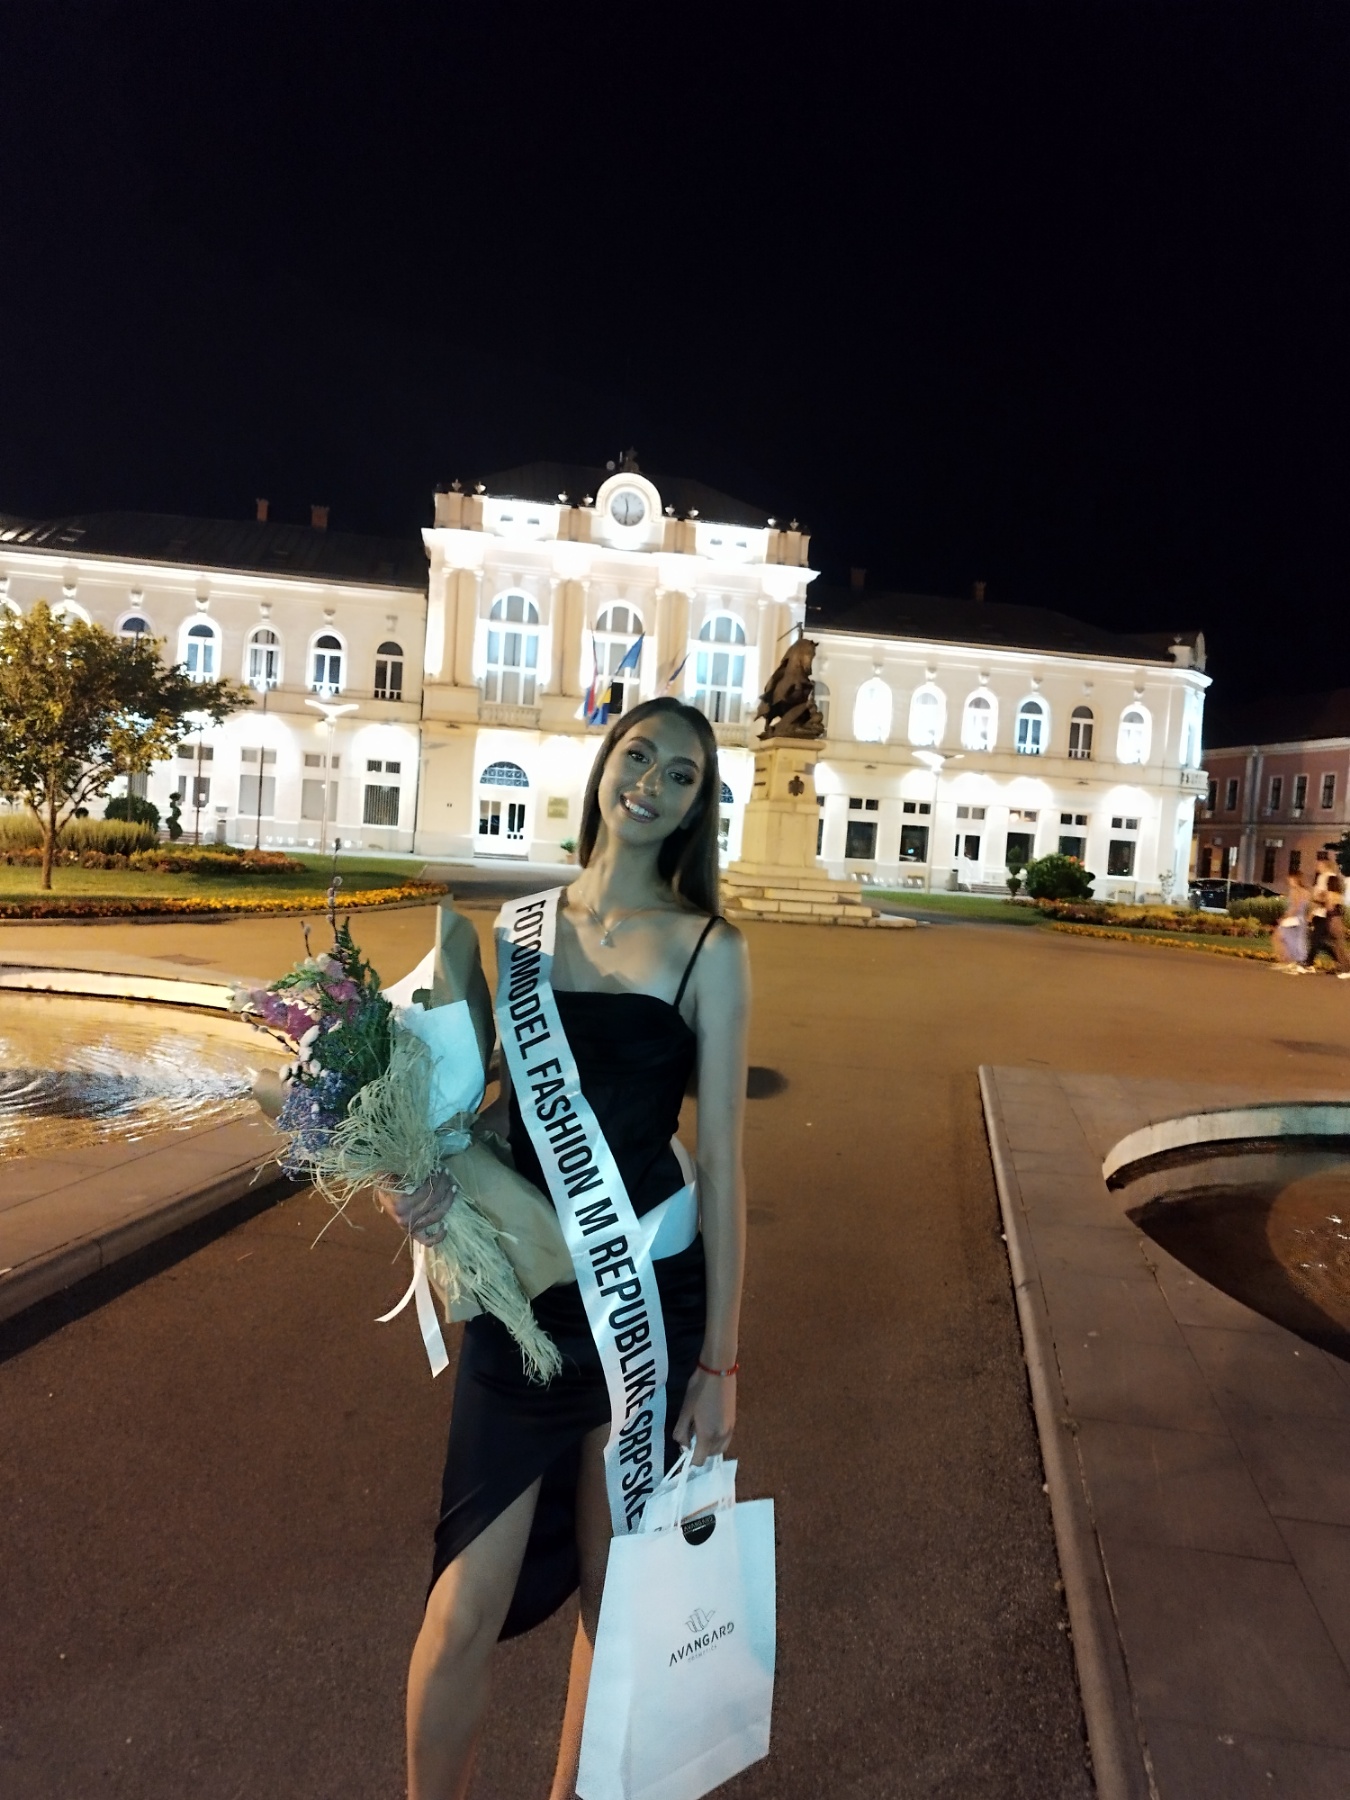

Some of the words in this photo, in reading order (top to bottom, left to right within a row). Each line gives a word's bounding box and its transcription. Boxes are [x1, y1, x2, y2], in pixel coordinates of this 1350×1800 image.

[508, 900, 551, 1060] FOTOMODEL
[527, 1057, 604, 1199] FASHION
[574, 1197, 619, 1237] M
[589, 1234, 656, 1420] REPUBLIKE
[669, 1621, 734, 1667] AVANGARD
